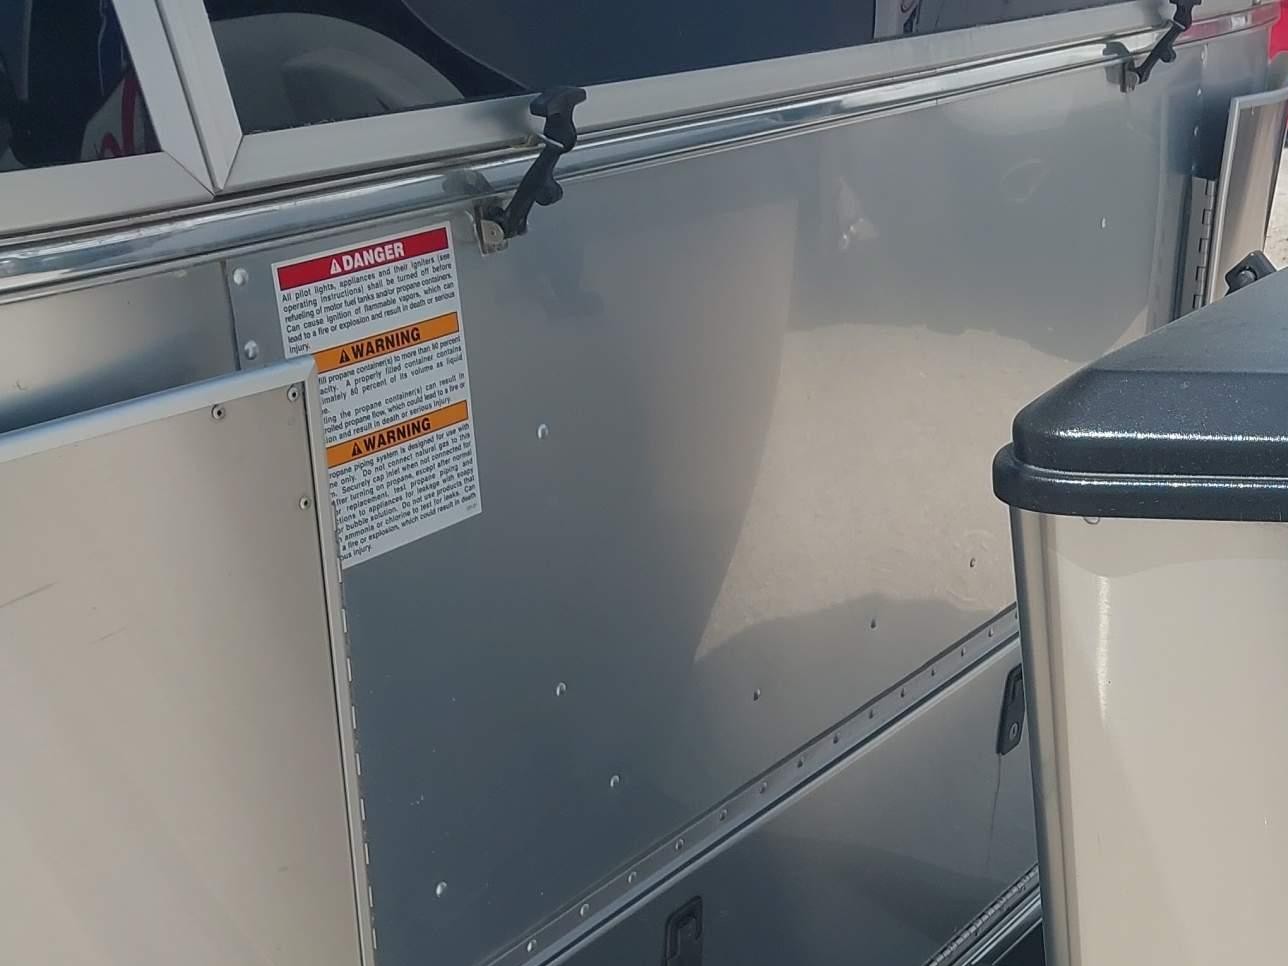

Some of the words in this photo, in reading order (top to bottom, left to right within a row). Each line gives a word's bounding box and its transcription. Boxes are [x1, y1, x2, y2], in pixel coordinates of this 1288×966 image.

[342, 242, 404, 271] DANGER
[282, 293, 291, 302] All
[295, 288, 311, 301] pilot
[340, 273, 375, 288] appliances
[379, 267, 391, 277] and
[394, 264, 408, 273] their
[283, 299, 317, 314] operating
[320, 285, 364, 303] instructions)
[367, 279, 383, 291] shall
[397, 270, 418, 282] turned
[432, 263, 452, 273] before
[285, 310, 315, 323] refueling
[314, 306, 322, 315] of
[324, 302, 343, 313] motor
[344, 297, 356, 307] fuel
[357, 294, 375, 304] tanks
[396, 281, 420, 295] propane
[286, 324, 300, 333] Can
[303, 318, 324, 329] cause
[326, 311, 352, 324] ignition
[355, 306, 361, 315] of
[364, 298, 396, 312] flammable
[444, 282, 454, 290] can
[288, 333, 302, 343] lead
[318, 327, 329, 335] fire
[339, 316, 370, 330] explosion
[371, 311, 382, 320] and
[384, 306, 401, 317] result
[435, 292, 455, 302] serious
[318, 376, 327, 384] fill
[328, 370, 355, 384] propane
[401, 350, 416, 360] more
[418, 346, 431, 354] than
[351, 328, 420, 360] WARNING
[354, 371, 382, 387] properly
[385, 363, 401, 374] filled
[404, 355, 433, 368] container
[436, 345, 462, 358] contains
[390, 374, 396, 383] of
[411, 365, 433, 376] volume
[340, 411, 351, 419] the
[355, 401, 382, 416] propane
[426, 383, 436, 391] can
[439, 375, 456, 386] result
[344, 415, 370, 429] propane
[424, 390, 436, 400] lead
[449, 384, 458, 392] fire
[339, 429, 351, 440] and
[353, 422, 372, 435] result
[374, 420, 380, 428] in
[409, 403, 432, 416] serious
[364, 419, 431, 453] WARNING
[342, 479, 370, 494] Securely
[373, 474, 384, 483] cap
[385, 467, 400, 478] inlet
[402, 462, 418, 471] when
[420, 456, 430, 465] not
[432, 444, 462, 461] connected
[354, 459, 374, 472] piping
[376, 450, 398, 463] system
[408, 435, 434, 451] designed
[446, 429, 456, 437] use
[362, 469, 372, 477] Do
[375, 463, 385, 473] not
[388, 453, 413, 468] connect
[459, 433, 470, 441] this
[350, 488, 374, 501] turning
[416, 463, 435, 476] except
[437, 458, 450, 468] after
[394, 484, 406, 494] test
[410, 473, 436, 489] propane
[440, 464, 458, 478] piping
[462, 457, 473, 467] and
[345, 524, 374, 541] ammonia
[420, 501, 432, 511] test
[464, 484, 475, 493] Can
[346, 518, 368, 531] bubble
[402, 501, 411, 509] Do
[412, 496, 422, 505] not
[424, 492, 435, 500] use
[436, 481, 462, 497] products
[348, 540, 358, 548] fire
[437, 501, 453, 512] result
[369, 495, 403, 513] appliances
